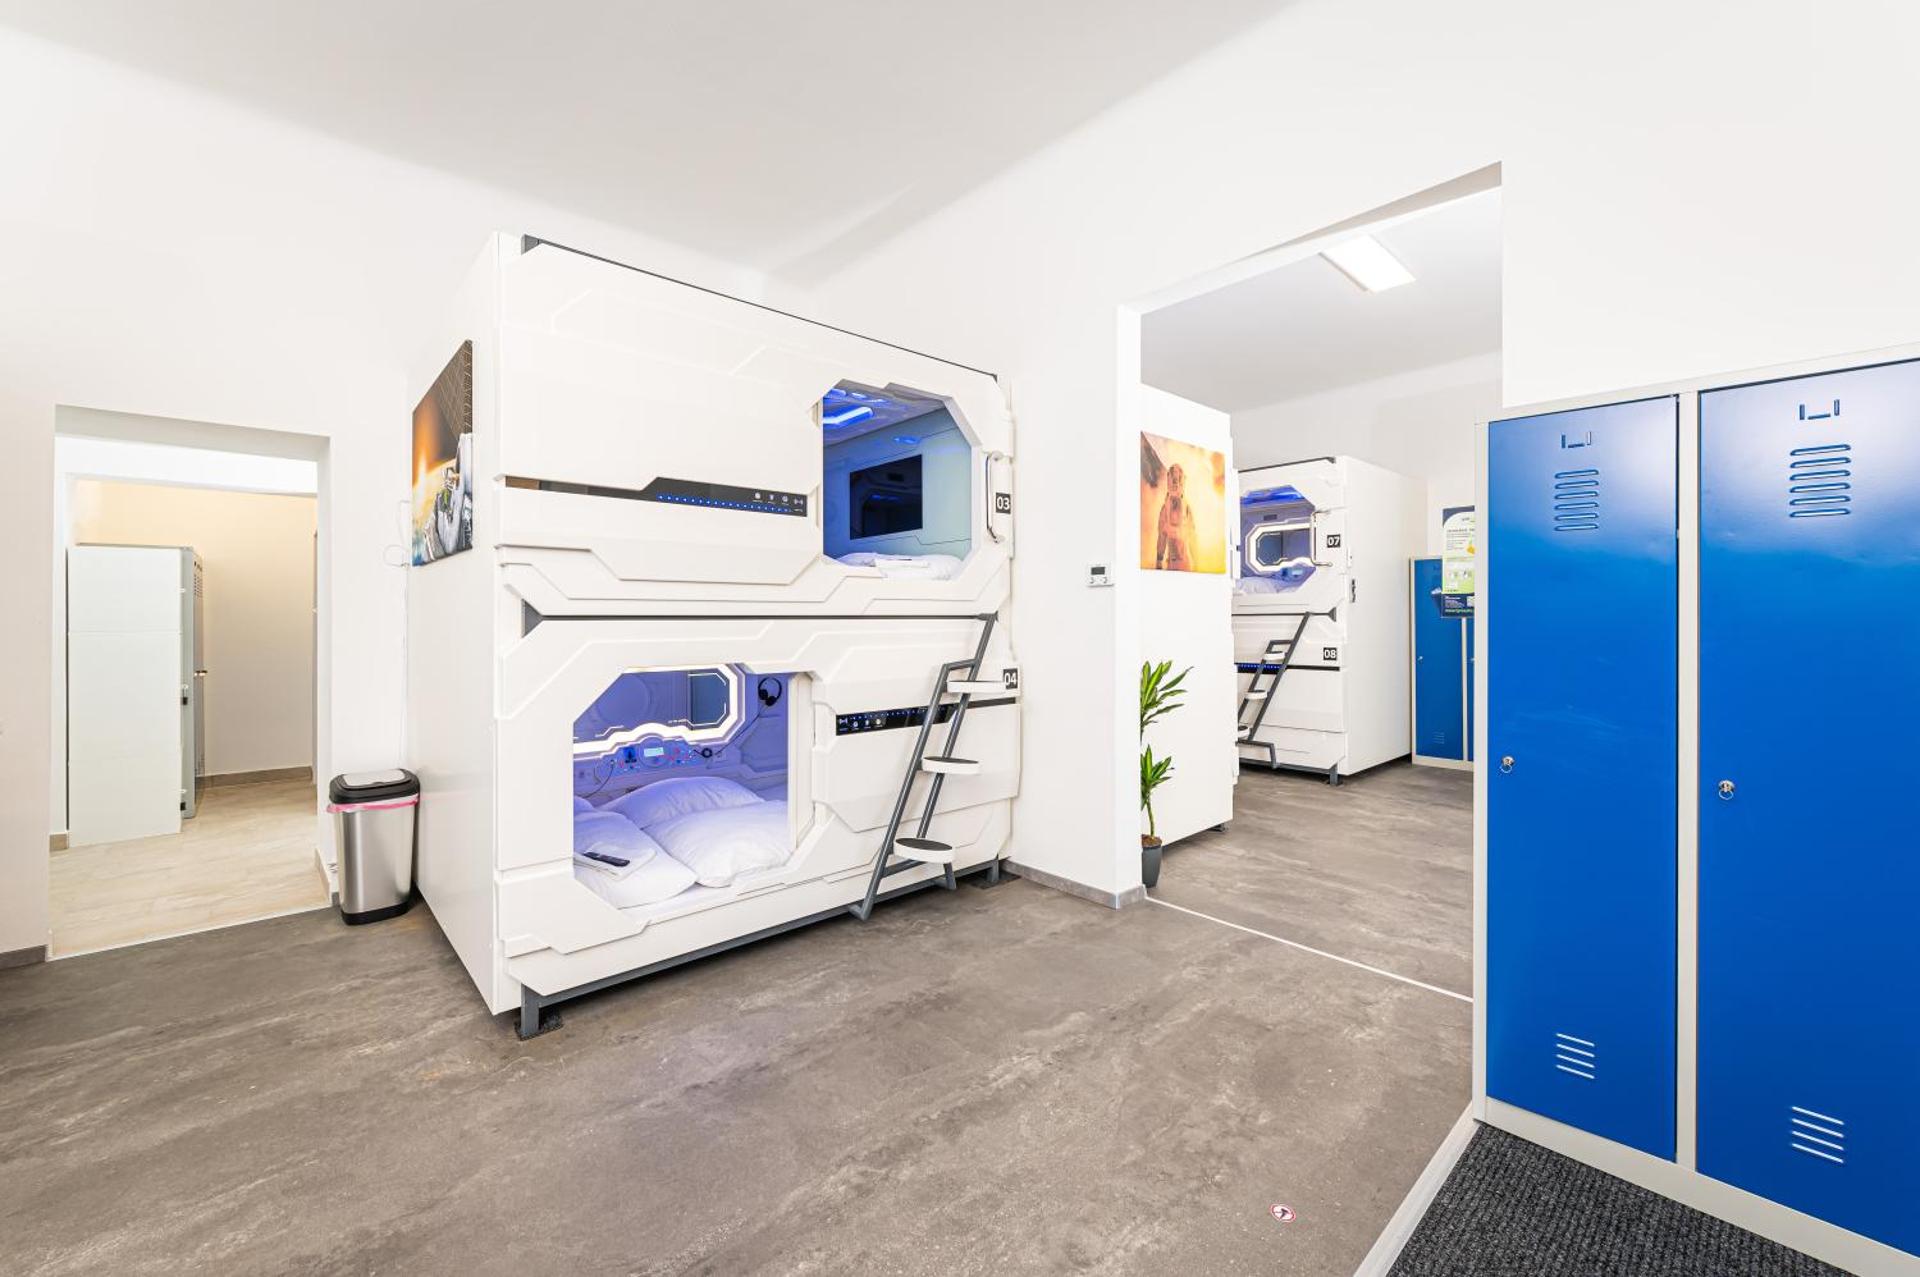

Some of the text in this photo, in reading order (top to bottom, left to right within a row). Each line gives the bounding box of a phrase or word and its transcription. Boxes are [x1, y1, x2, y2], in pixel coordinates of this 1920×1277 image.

[996, 496, 1010, 510] 03
[1328, 536, 1340, 546] 07
[1324, 649, 1336, 659] 08
[1004, 672, 1017, 686] 04
